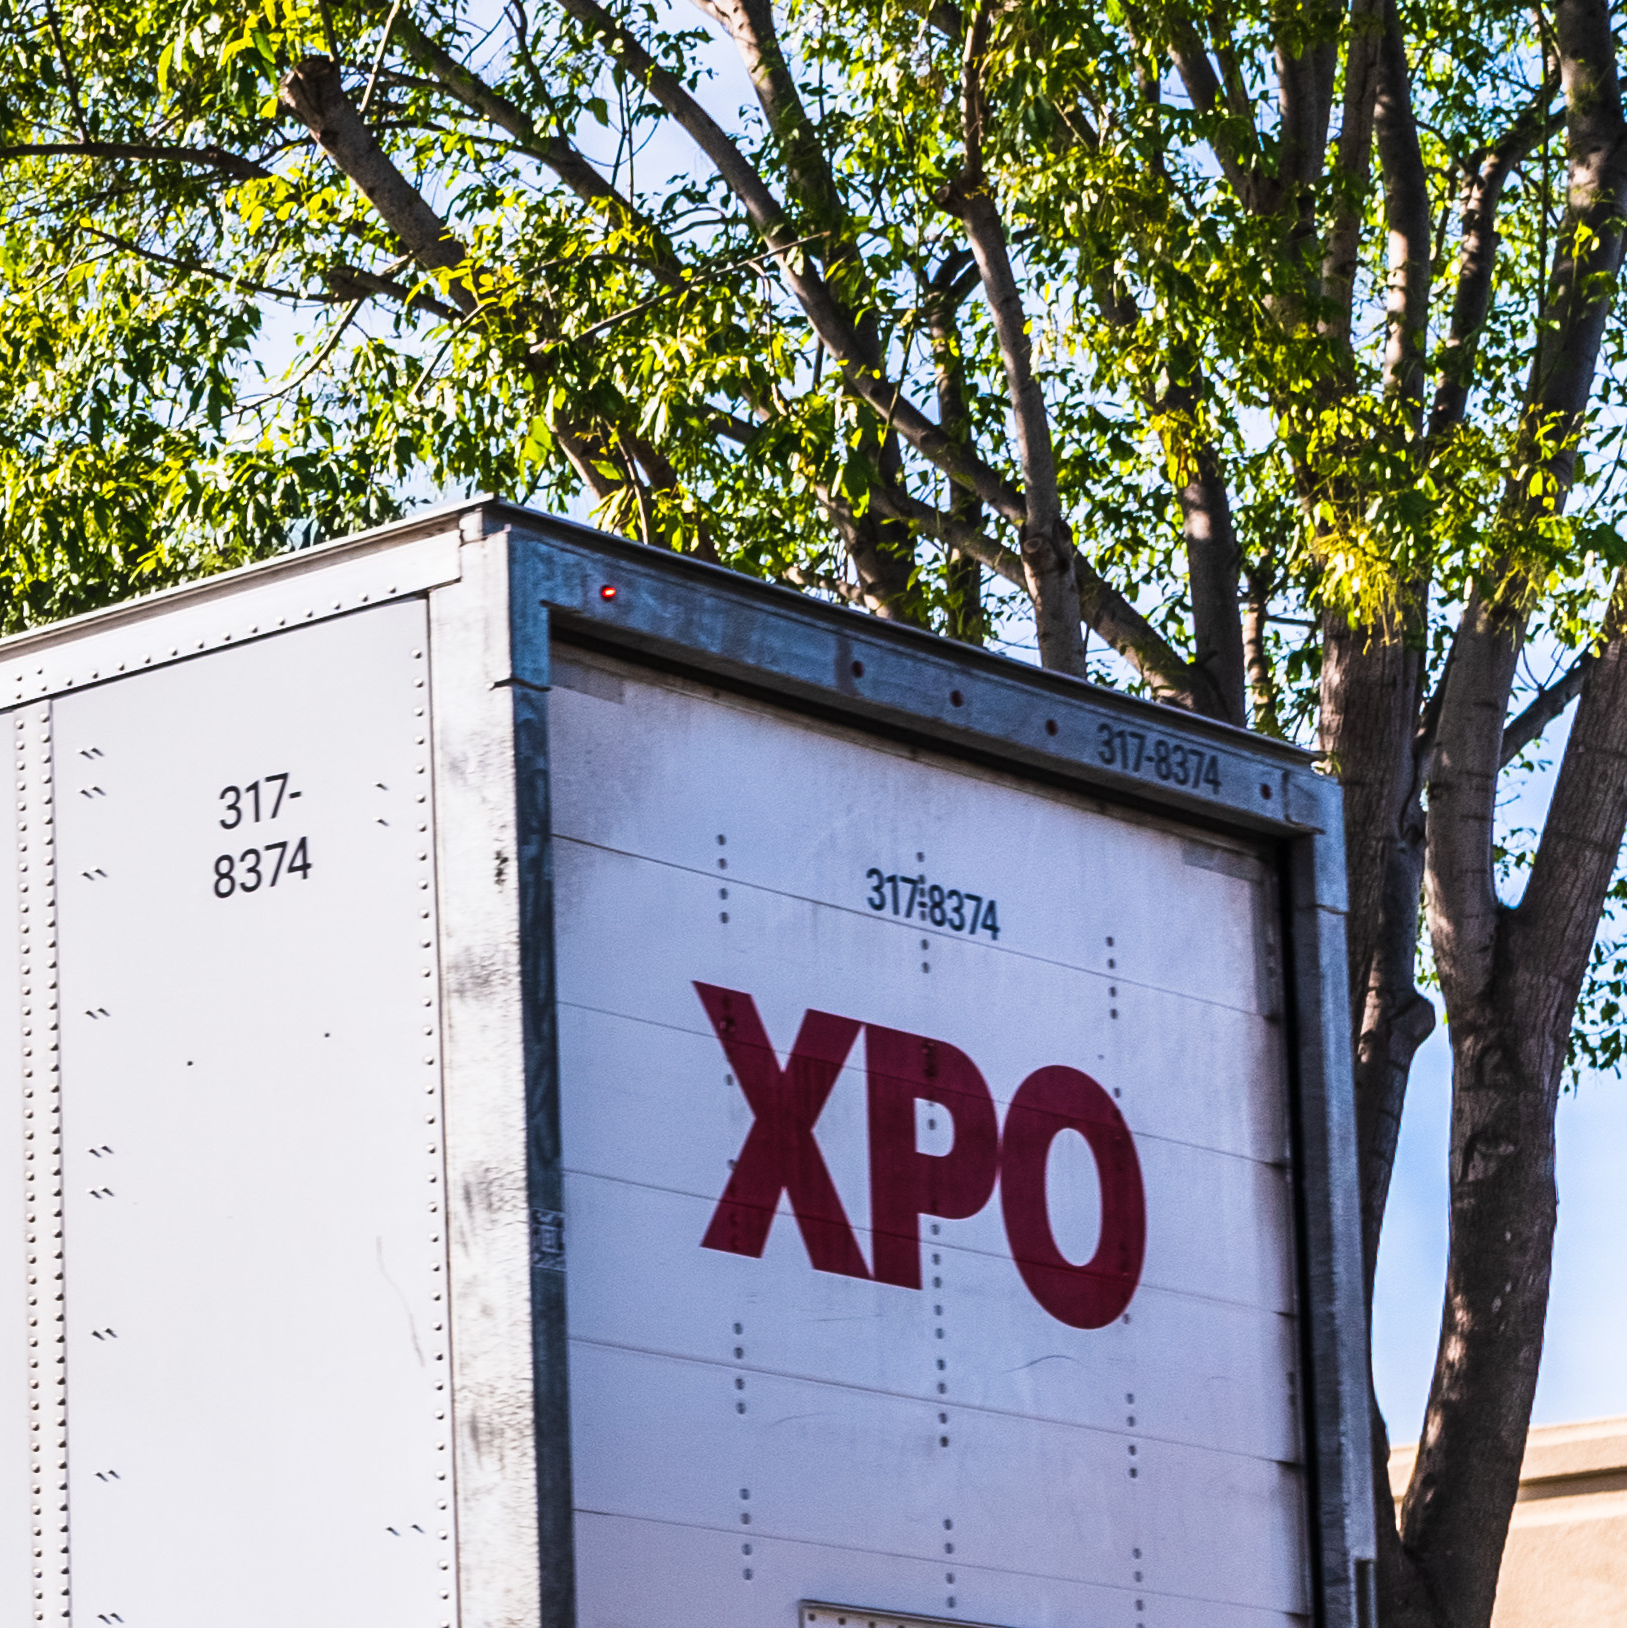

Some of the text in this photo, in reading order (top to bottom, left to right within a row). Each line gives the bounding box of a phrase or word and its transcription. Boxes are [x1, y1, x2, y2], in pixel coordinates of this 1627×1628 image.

[1097, 721, 1221, 795] 317-8374
[218, 772, 303, 830] 317-
[212, 836, 312, 899] 8374
[866, 868, 1000, 941] 317-8374
[691, 979, 1146, 1330] XPO
